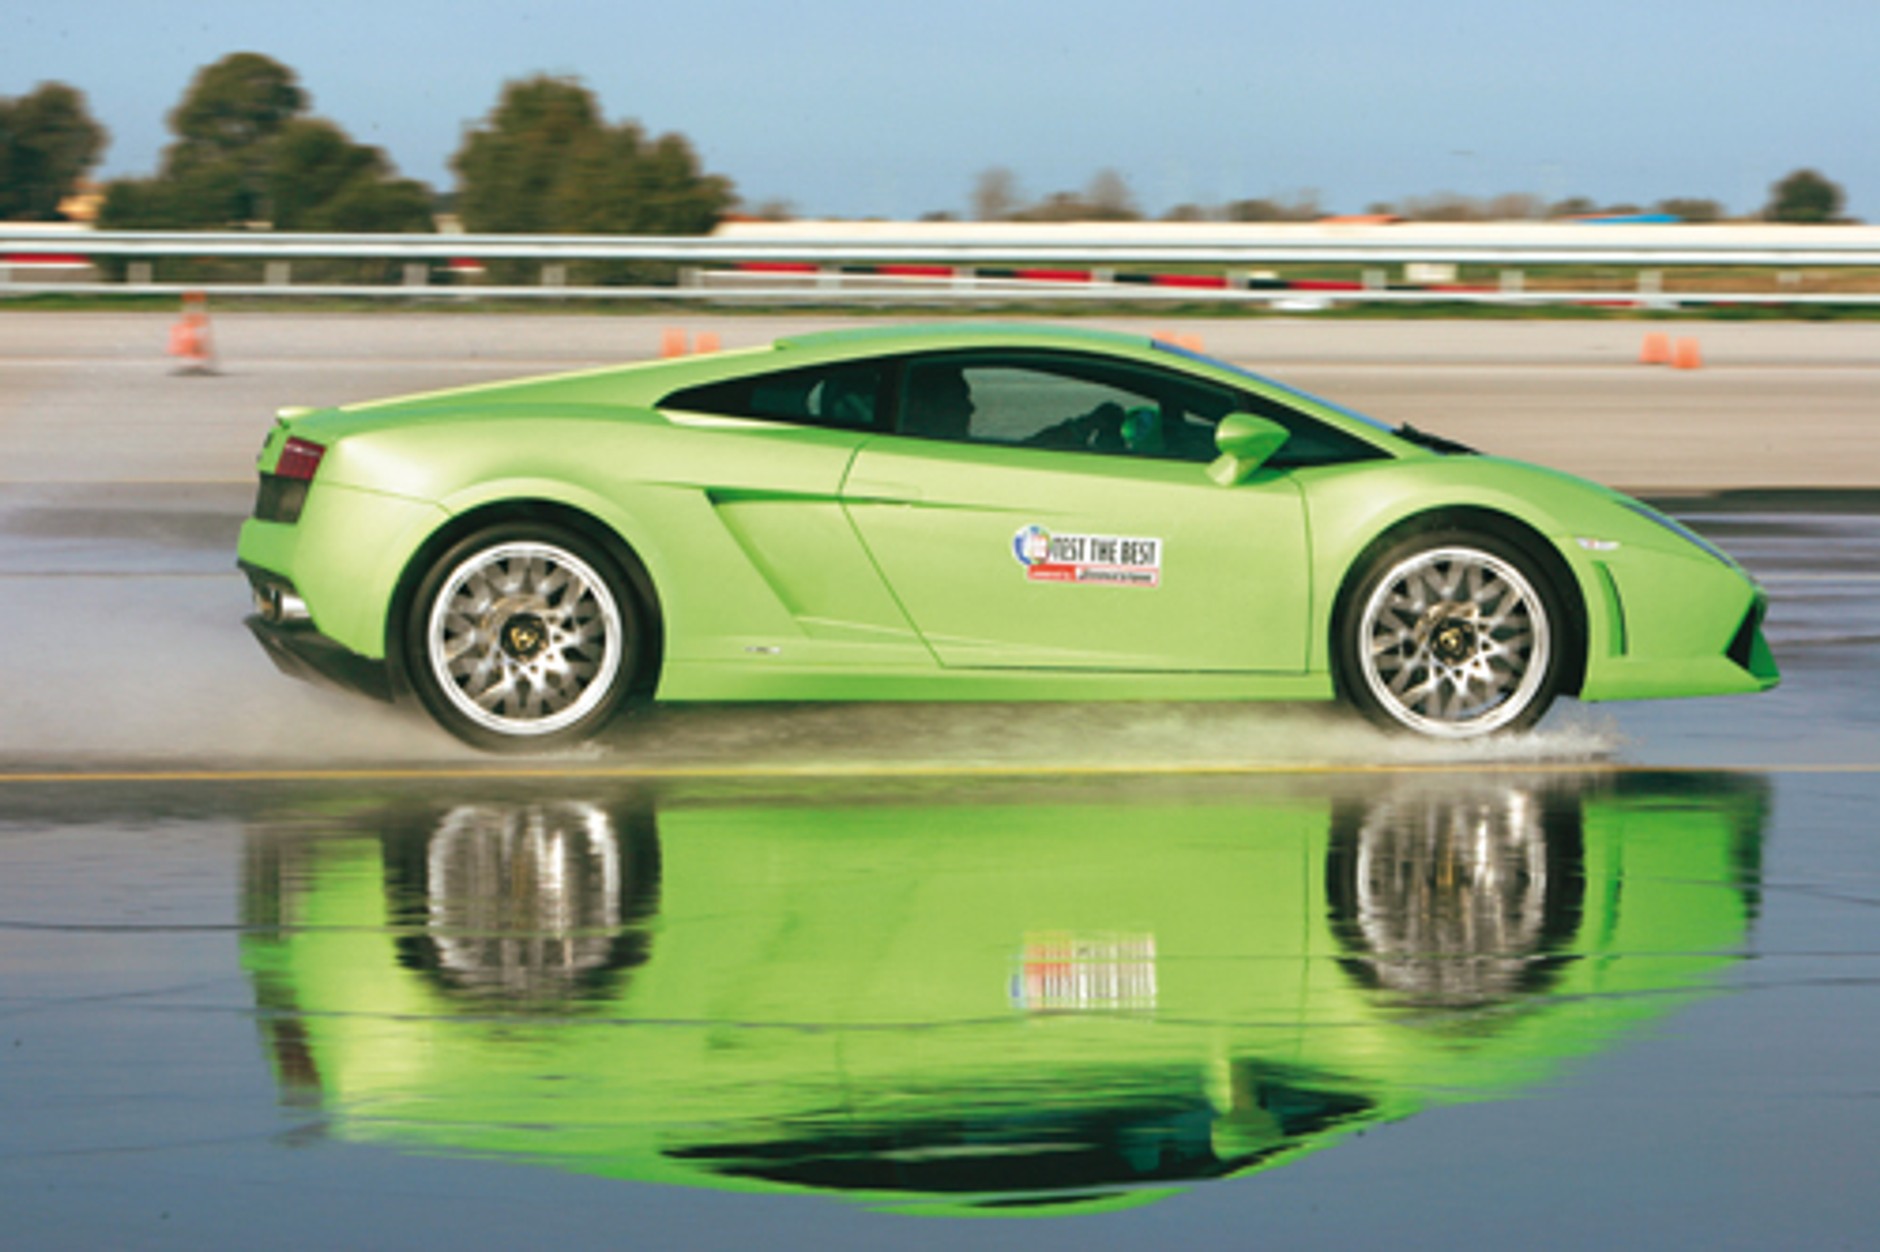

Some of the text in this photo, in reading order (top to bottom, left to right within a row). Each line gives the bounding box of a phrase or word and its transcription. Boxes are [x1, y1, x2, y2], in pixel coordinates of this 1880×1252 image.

[1053, 536, 1156, 565] TEST THE BEST
